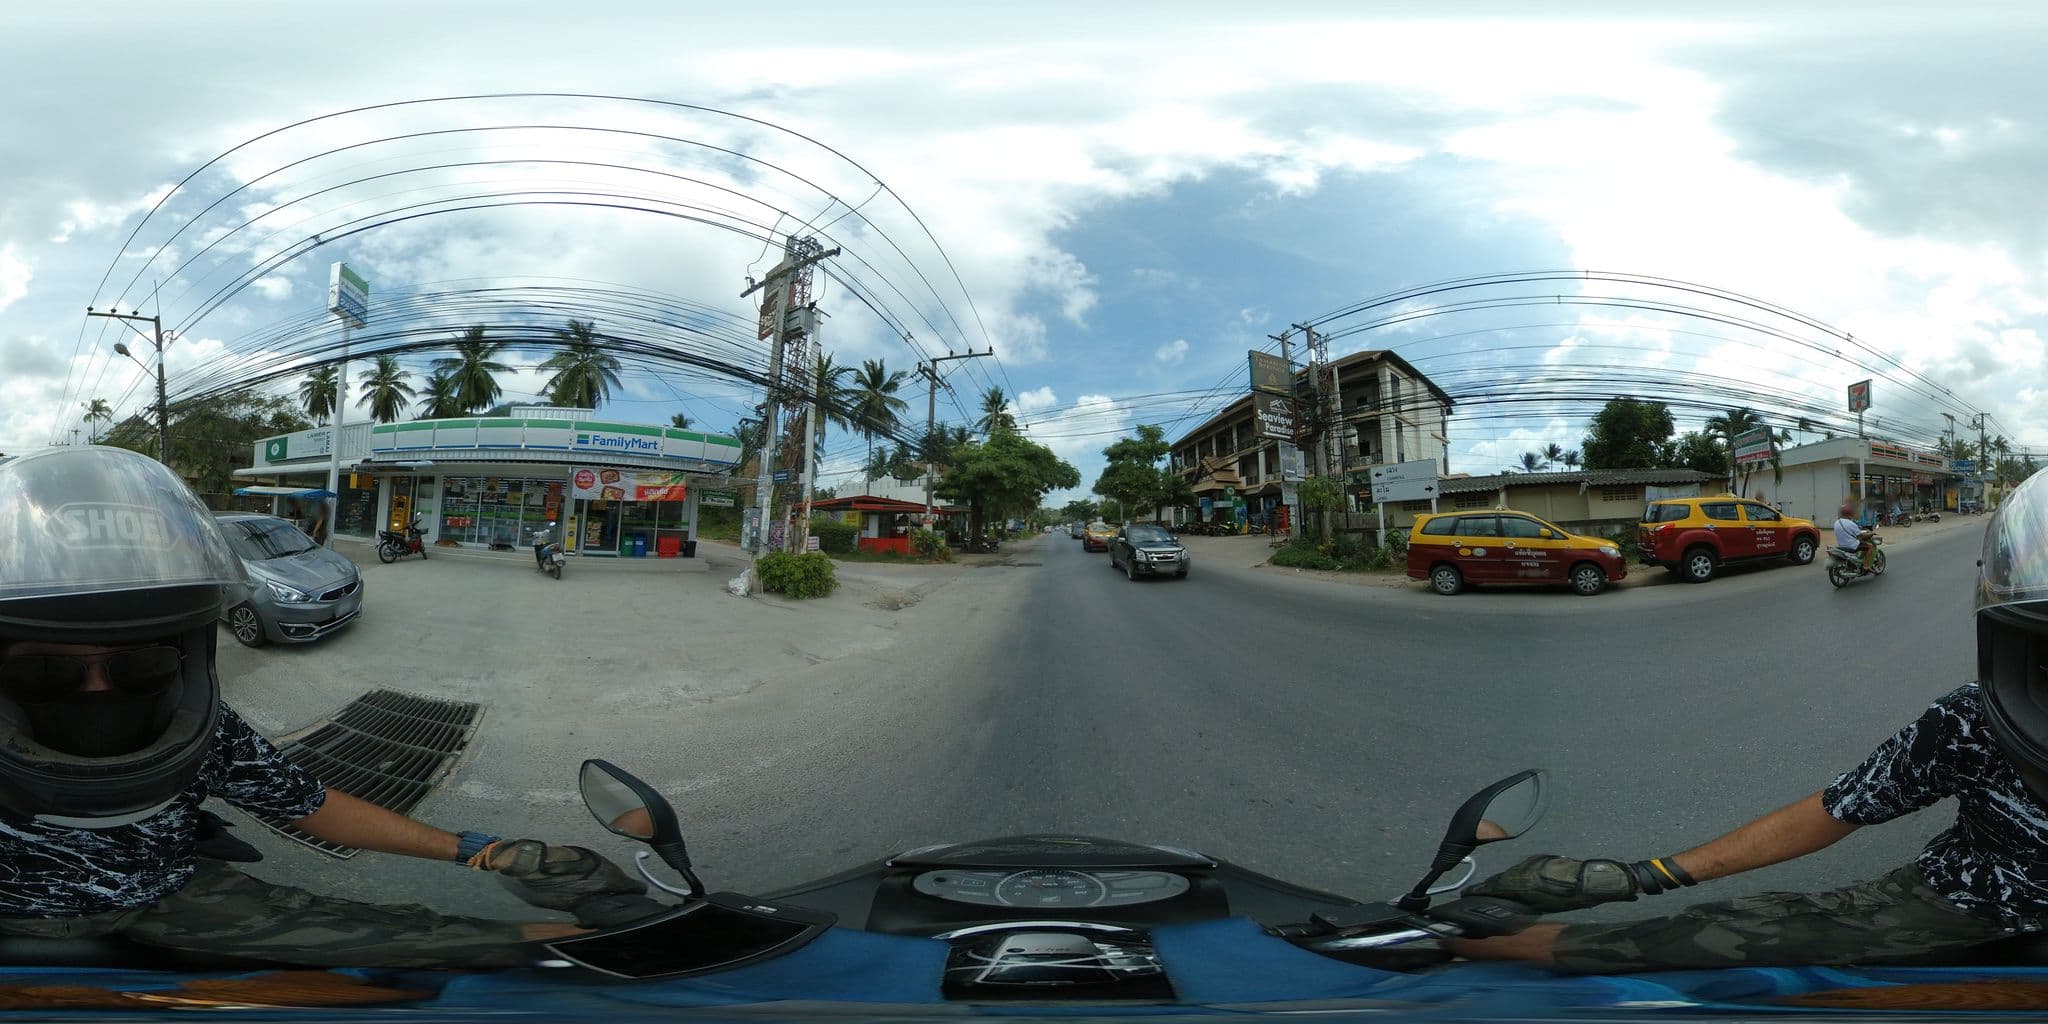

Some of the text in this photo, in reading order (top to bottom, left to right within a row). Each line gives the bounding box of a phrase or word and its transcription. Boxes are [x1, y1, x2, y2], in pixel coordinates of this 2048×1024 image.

[1257, 409, 1293, 426] Seaview
[1265, 421, 1294, 435] Paradise
[592, 435, 658, 450] FamilyMart
[63, 509, 169, 542] SHOEI
